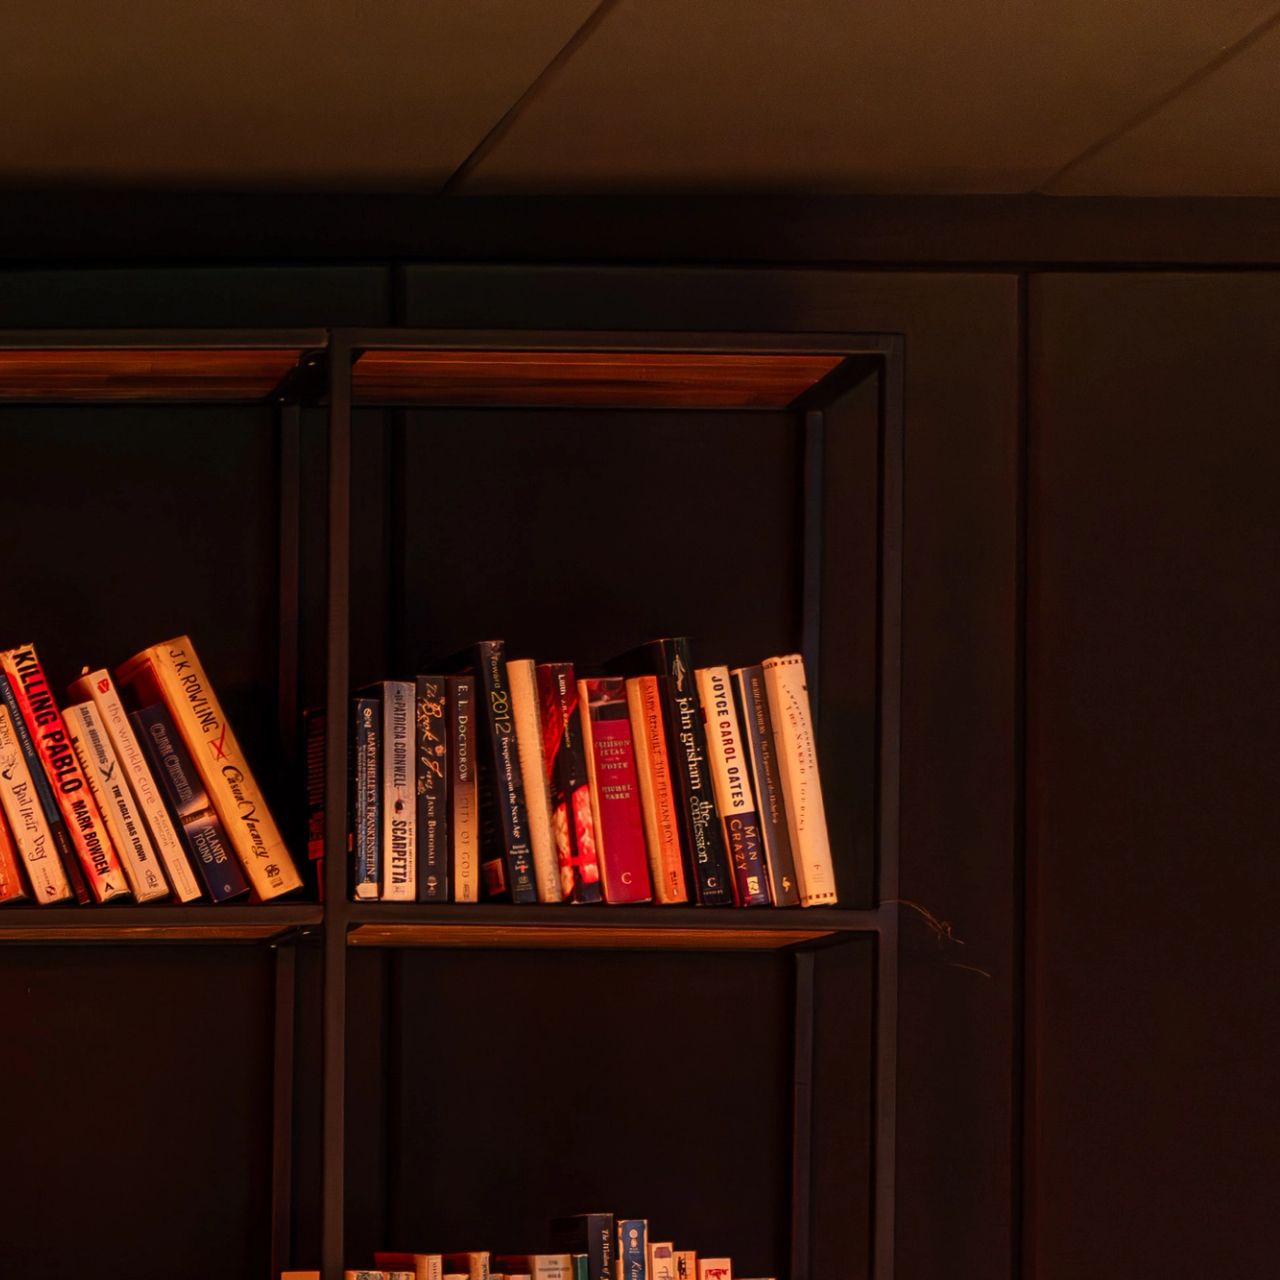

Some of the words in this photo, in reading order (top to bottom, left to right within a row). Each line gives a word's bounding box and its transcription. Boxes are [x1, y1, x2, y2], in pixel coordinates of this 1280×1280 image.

[458, 685, 467, 696] E.
[490, 656, 500, 688] Toward
[558, 674, 567, 695] Lilith
[458, 700, 467, 711] L.
[491, 690, 511, 735] 2012
[676, 697, 695, 730] john
[712, 676, 729, 716] JOYCE
[108, 703, 123, 723] the
[119, 730, 143, 772] wrinkle
[139, 777, 155, 804] cure
[458, 715, 468, 781] DOCTOROW
[501, 737, 514, 781] Perspectives
[720, 721, 735, 763] CAROL
[13, 651, 57, 725] KILLING
[42, 730, 83, 794] PABLO
[71, 800, 91, 830] MARK
[84, 833, 109, 876] BOWDEN
[680, 733, 702, 790] grisham
[509, 793, 517, 804] the
[728, 767, 744, 807] OATES
[220, 765, 251, 806] Casual
[241, 808, 270, 859] Vacancy
[460, 798, 469, 824] CITY
[510, 806, 518, 820] Next
[690, 796, 709, 863] confession
[193, 834, 213, 863] FOUND
[203, 826, 228, 864] ATLANTIS
[367, 806, 376, 875] FRANKENSTEIN
[461, 831, 469, 845] OF
[511, 823, 520, 838] Age
[664, 825, 672, 844] BOY
[731, 819, 746, 870] CRAZY
[461, 852, 470, 878] GOD
